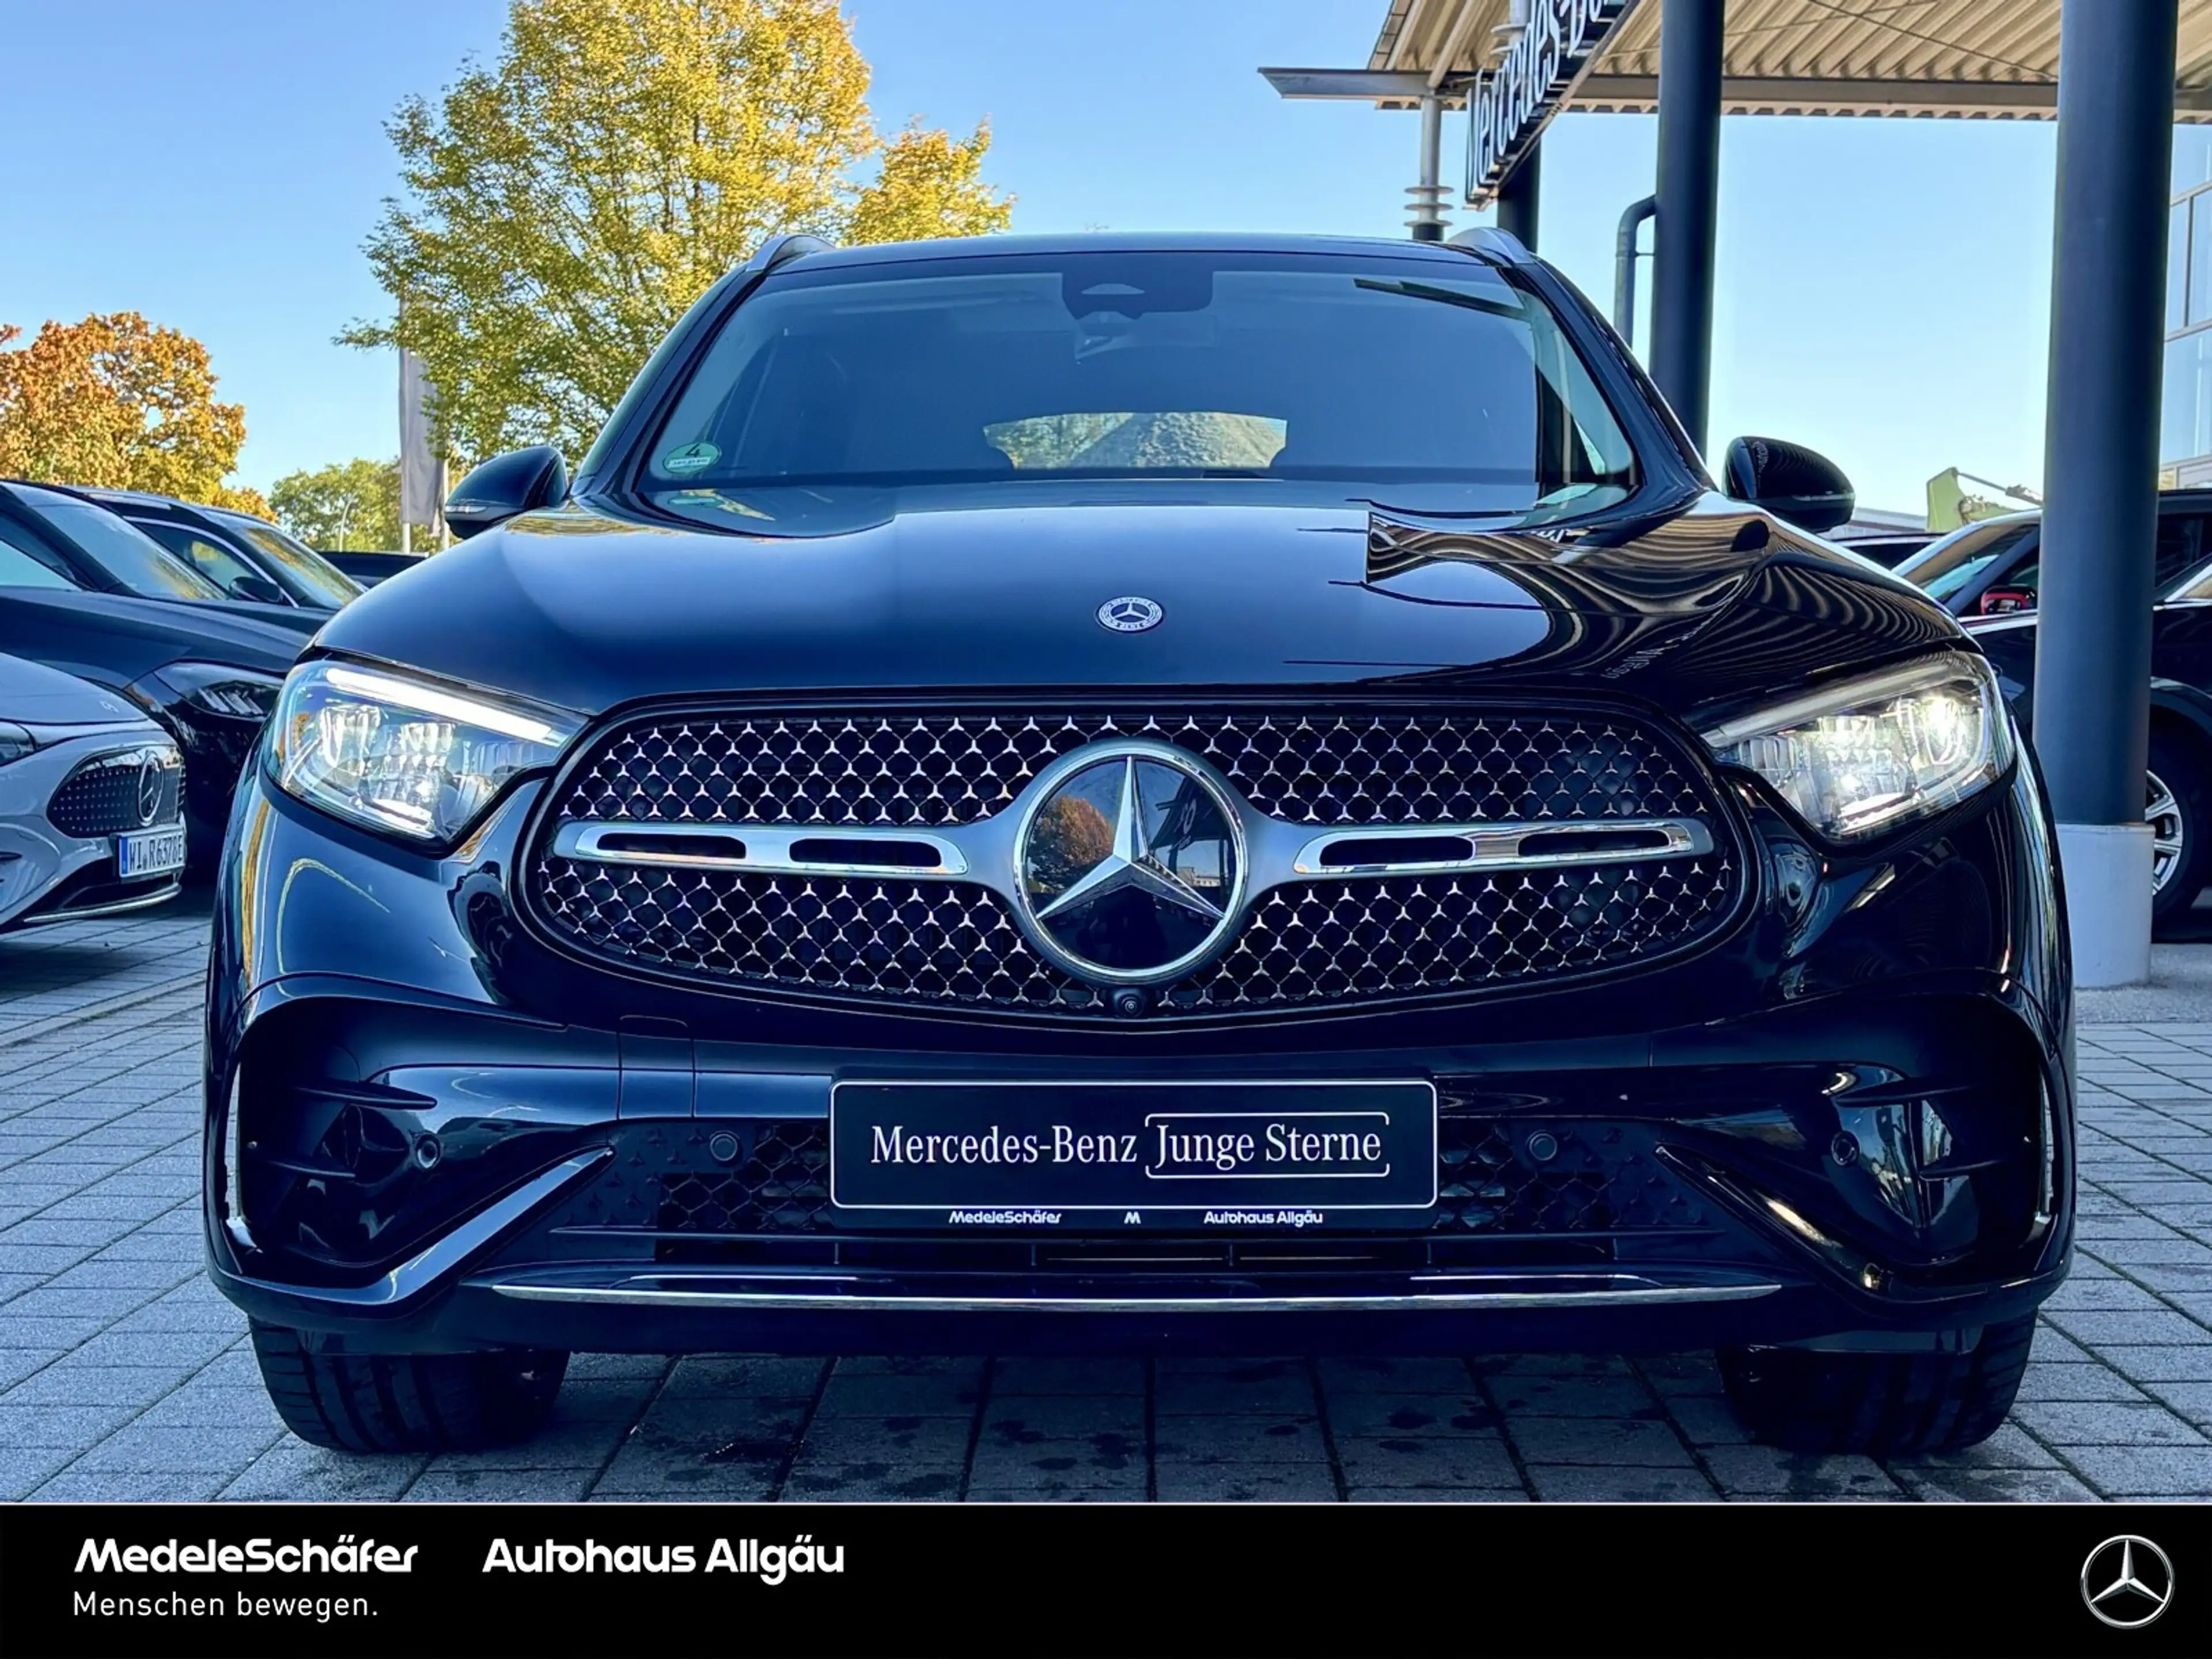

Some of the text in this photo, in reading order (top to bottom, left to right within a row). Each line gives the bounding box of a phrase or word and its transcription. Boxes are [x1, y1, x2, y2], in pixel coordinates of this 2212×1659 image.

[1465, 0, 1608, 200] Mercedes-
[684, 442, 700, 457] 4
[871, 1123, 1381, 1171] Mercedes-Benz Junge Sterne
[948, 1210, 1062, 1224] MedeleSchäfer
[1203, 1211, 1275, 1225] Autohaus
[1275, 1210, 1324, 1228] Allgäu
